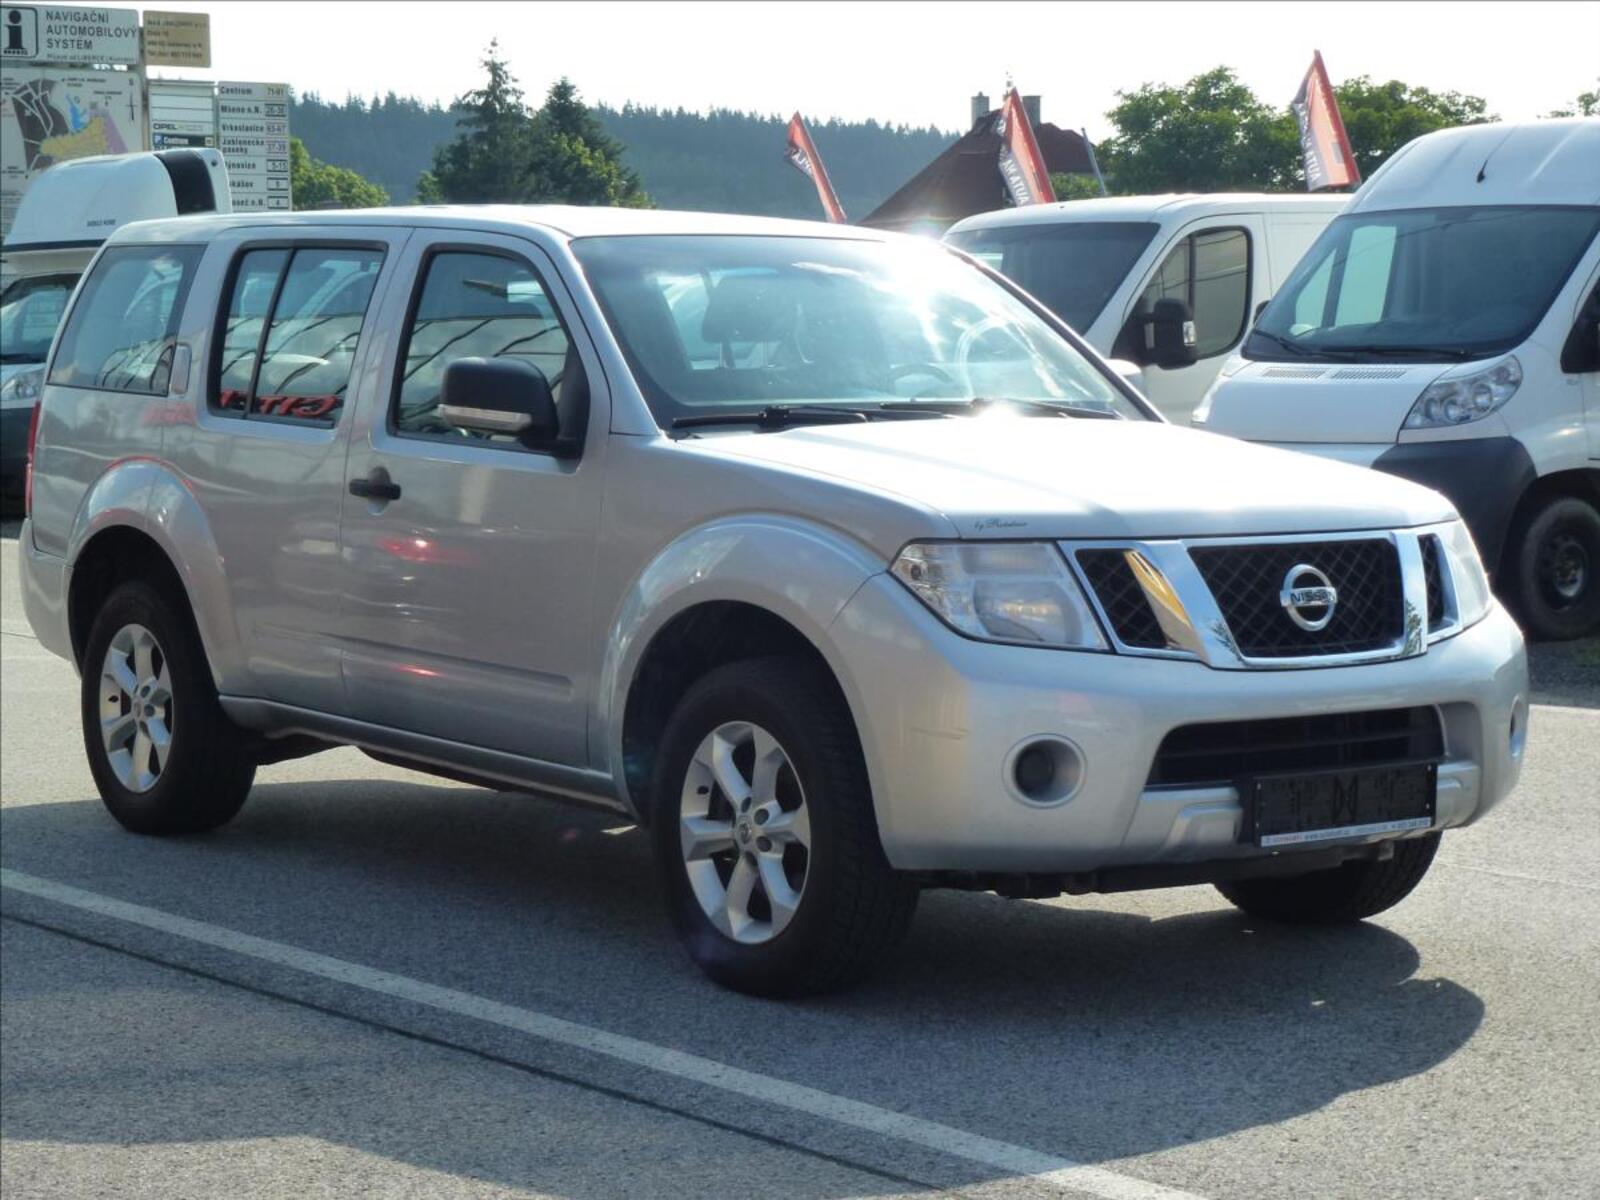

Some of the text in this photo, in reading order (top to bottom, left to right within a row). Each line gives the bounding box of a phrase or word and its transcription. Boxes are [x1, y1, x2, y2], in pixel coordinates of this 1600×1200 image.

[46, 10, 109, 23] NAVIGAČNÍ
[46, 24, 137, 38] AUTOMOBILOVÝ
[220, 86, 252, 95] Centrum
[1290, 591, 1336, 603] NISSAN
